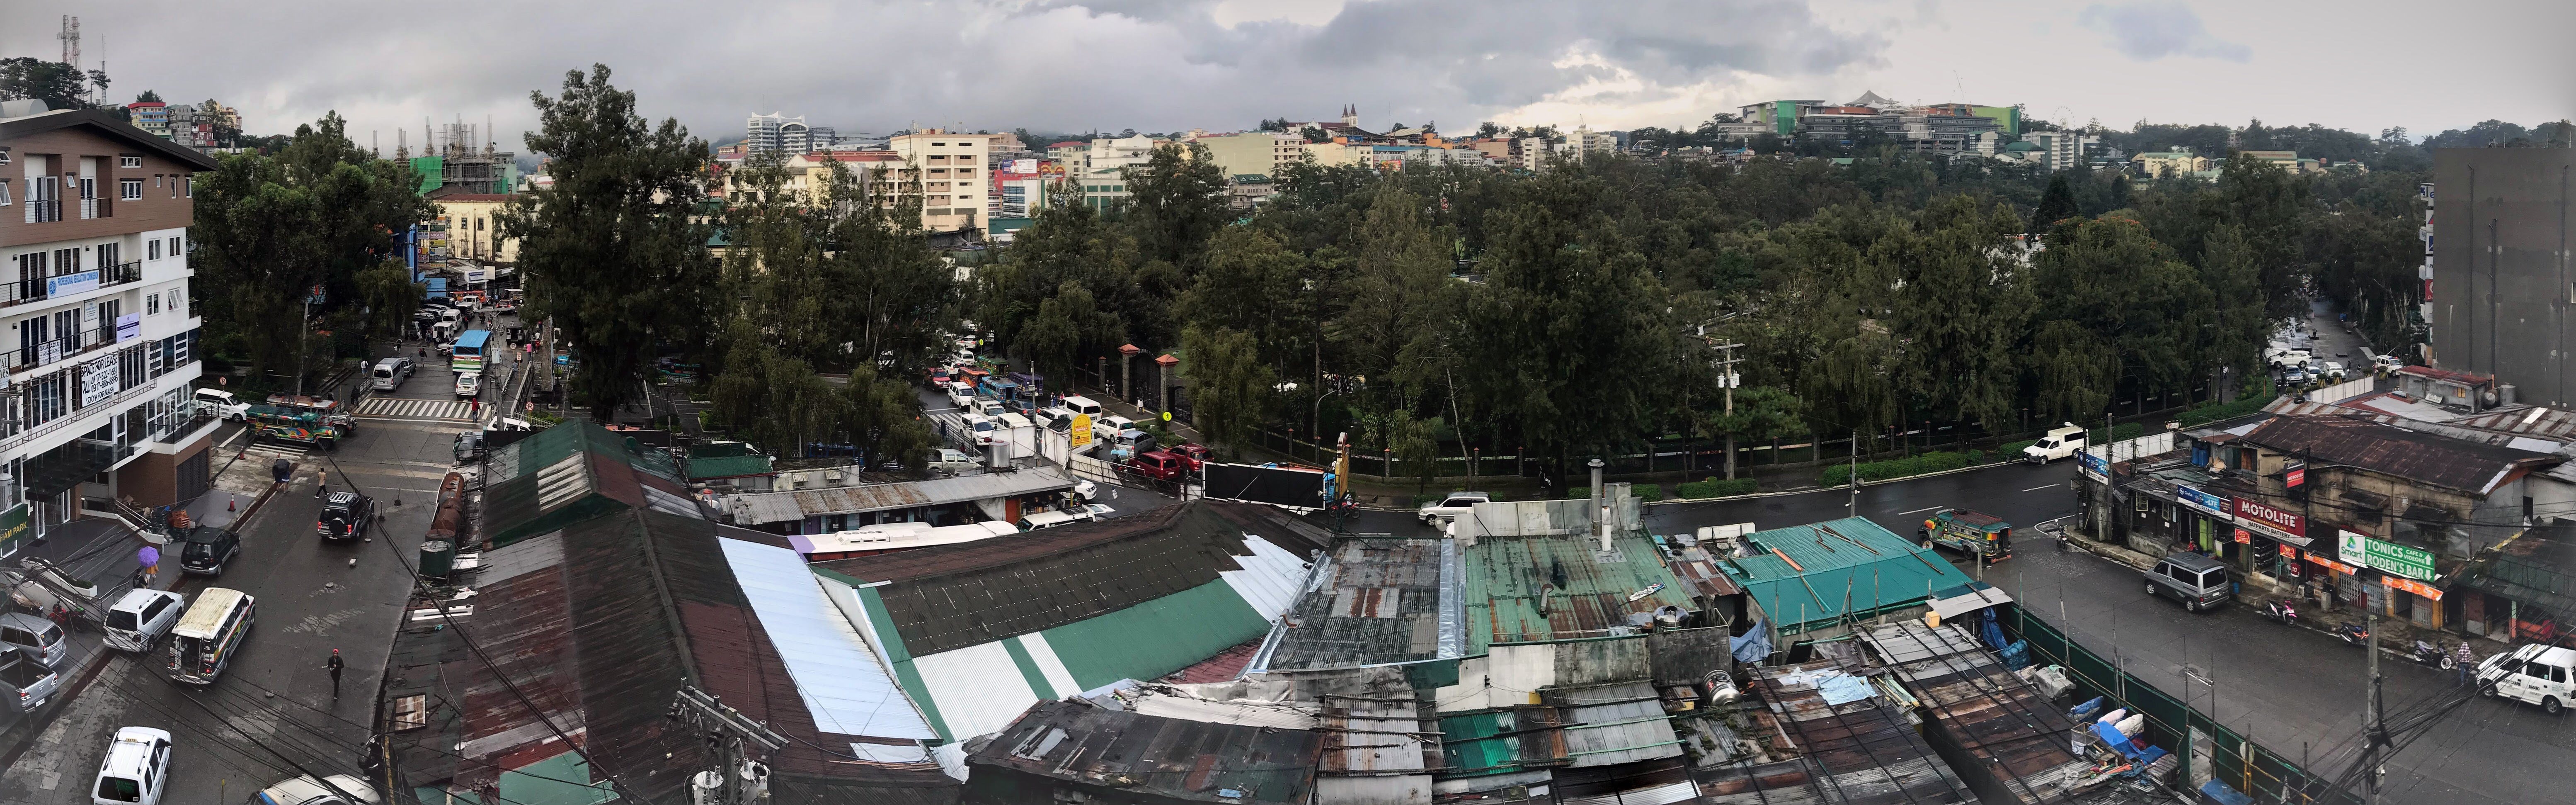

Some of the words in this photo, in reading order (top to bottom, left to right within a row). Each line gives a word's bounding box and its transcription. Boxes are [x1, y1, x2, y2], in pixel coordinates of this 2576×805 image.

[81, 364, 95, 377] SPACE
[105, 354, 117, 368] LEASE
[2194, 503, 2216, 514] ZALRIANES
[2242, 501, 2296, 528] MOTOLITE
[13, 521, 27, 535] PARK
[2248, 521, 2270, 532] BATPARTS
[2271, 529, 2290, 538] BATTERY
[2251, 517, 2287, 531] PANGMATAGALAN
[2341, 546, 2363, 559] Smart
[2366, 539, 2404, 558] TONICS
[2367, 554, 2404, 574] RODEN'S
[2406, 564, 2424, 579] BAR
[2404, 554, 2425, 564] VIDEOKE
